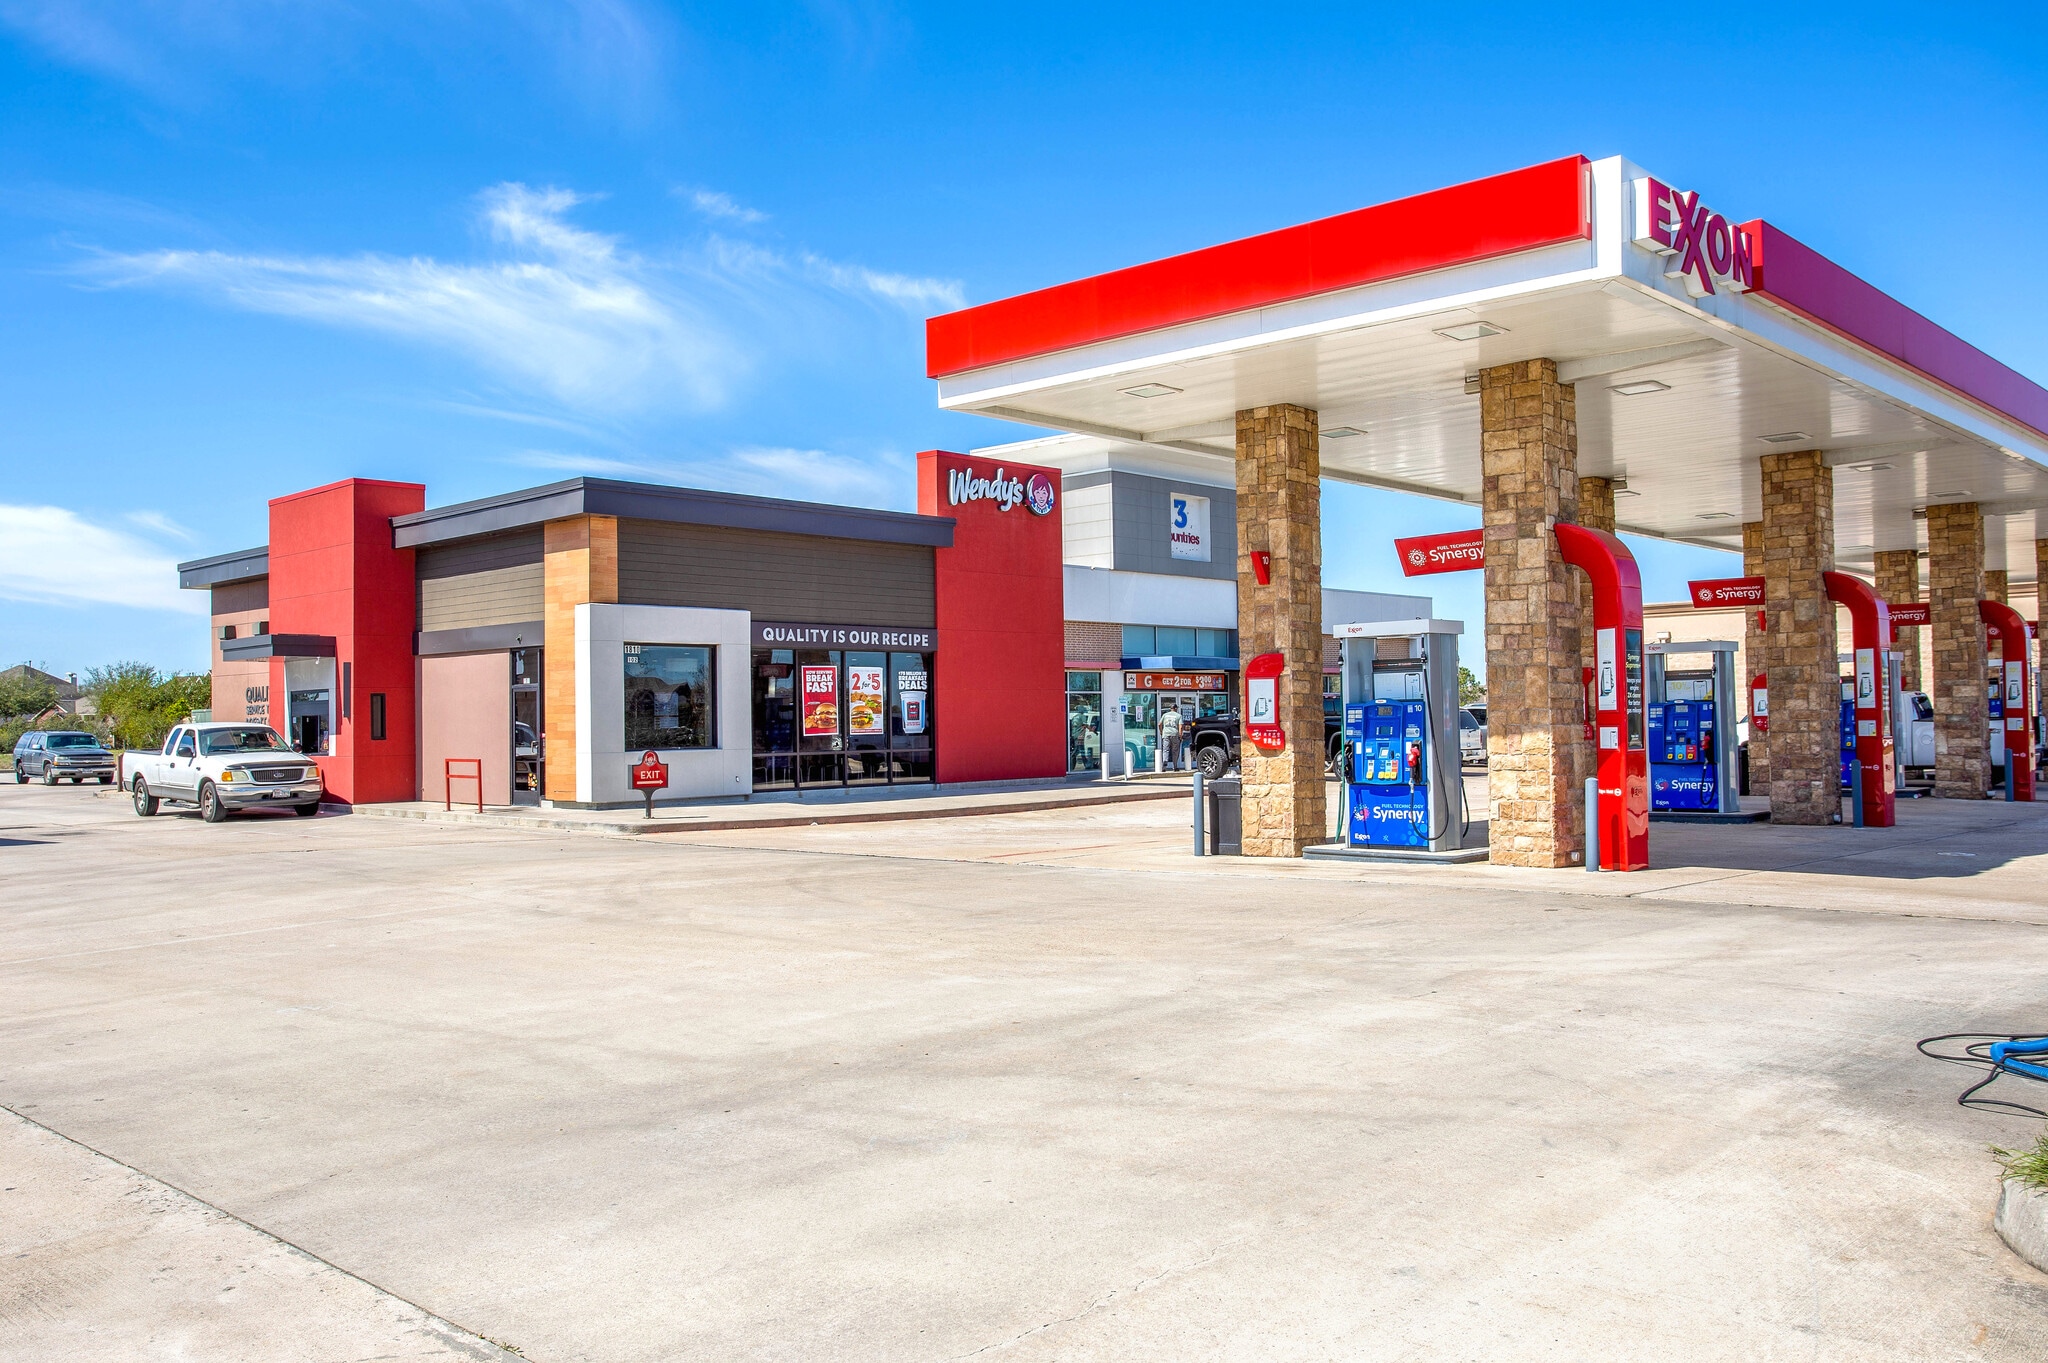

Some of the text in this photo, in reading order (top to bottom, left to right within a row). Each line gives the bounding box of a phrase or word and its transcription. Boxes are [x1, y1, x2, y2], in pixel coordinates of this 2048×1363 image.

[1648, 177, 1753, 295] EXXON
[948, 467, 1025, 512] Wendy's
[1173, 499, 1188, 529] 3
[1262, 556, 1270, 565] 10
[1429, 547, 1485, 563] Synergy
[1715, 589, 1762, 601] Synergy
[1888, 612, 1926, 622] Synergy
[762, 627, 929, 647] QUALITY IS OUR RECIPE
[806, 682, 833, 693] FAST
[852, 673, 861, 690] 2
[861, 681, 870, 689] for
[898, 681, 927, 690] DEALS
[640, 770, 660, 779] EXIT
[1671, 780, 1714, 792] Synergy
[1373, 806, 1424, 823] Synergy
[1354, 833, 1371, 841] Exxon
